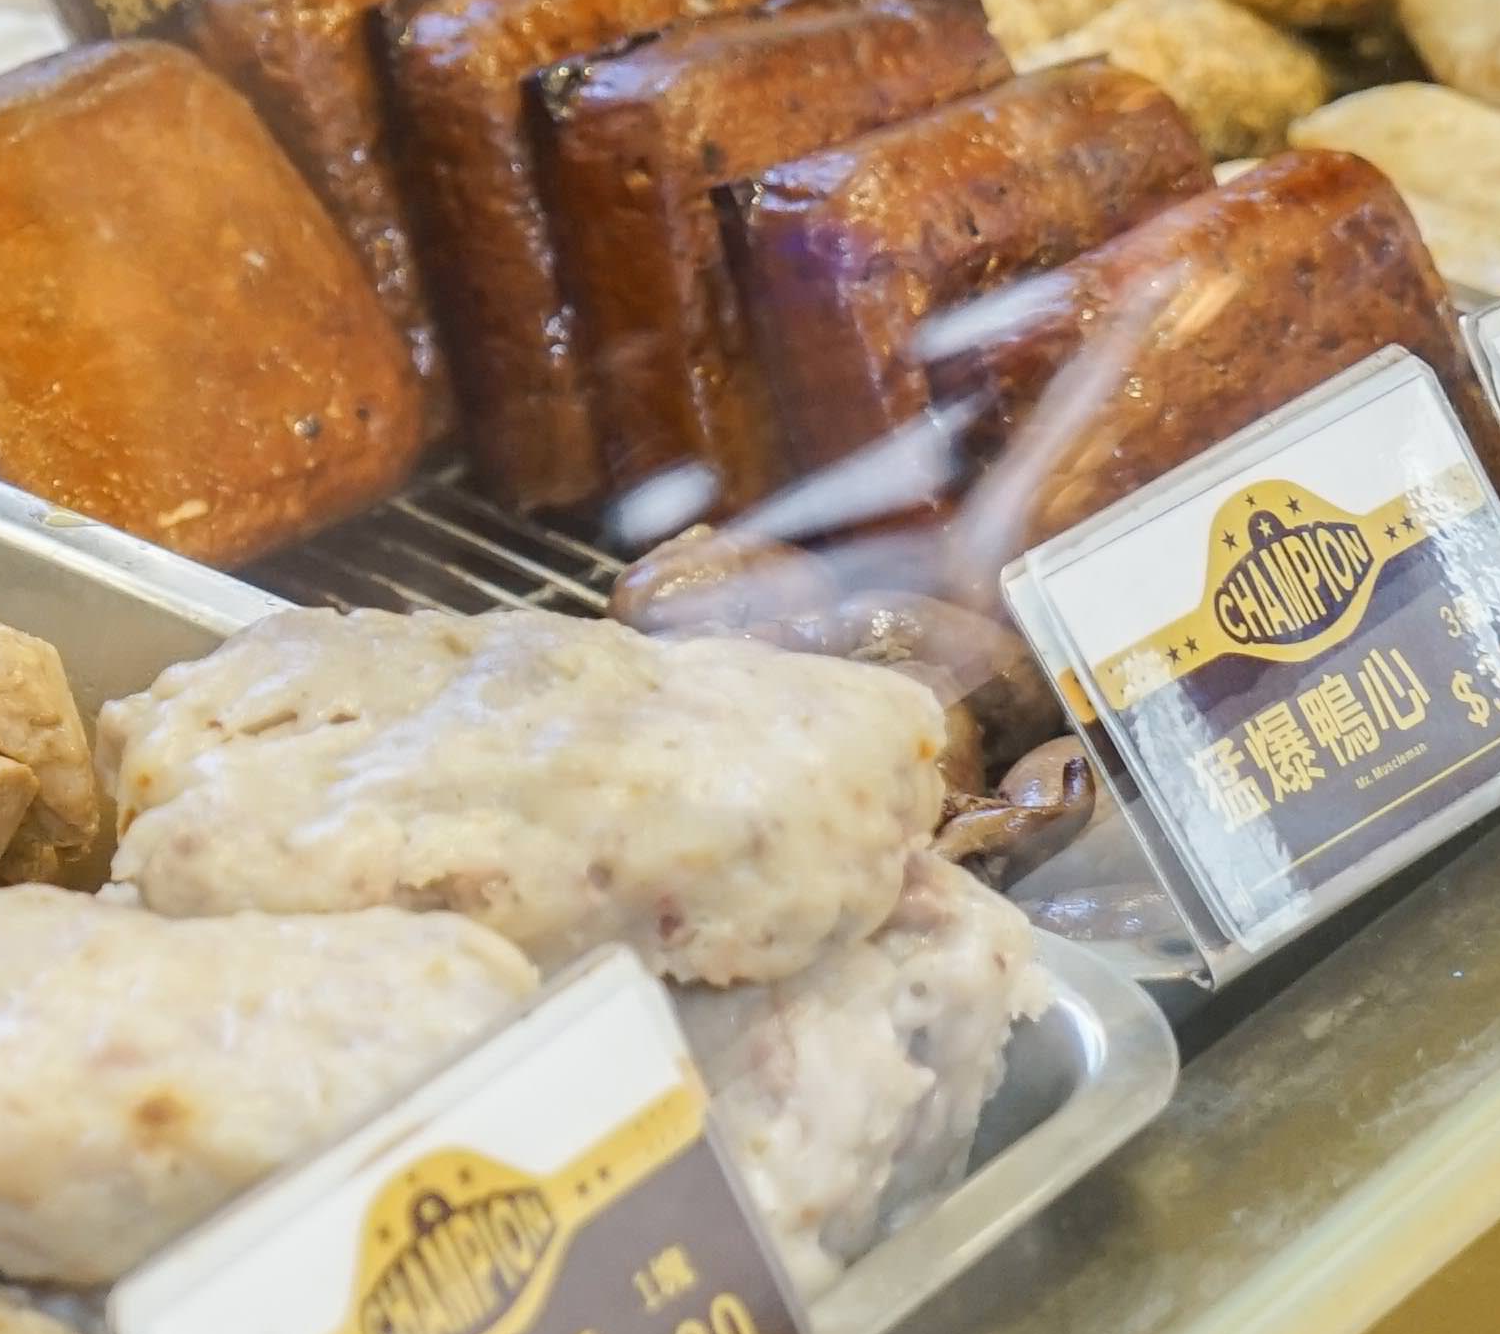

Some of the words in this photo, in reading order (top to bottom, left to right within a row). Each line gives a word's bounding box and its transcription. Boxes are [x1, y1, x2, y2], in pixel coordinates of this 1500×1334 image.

[1217, 523, 1369, 644] CHAMPION
[1191, 646, 1430, 833] 猛爆鴨心
